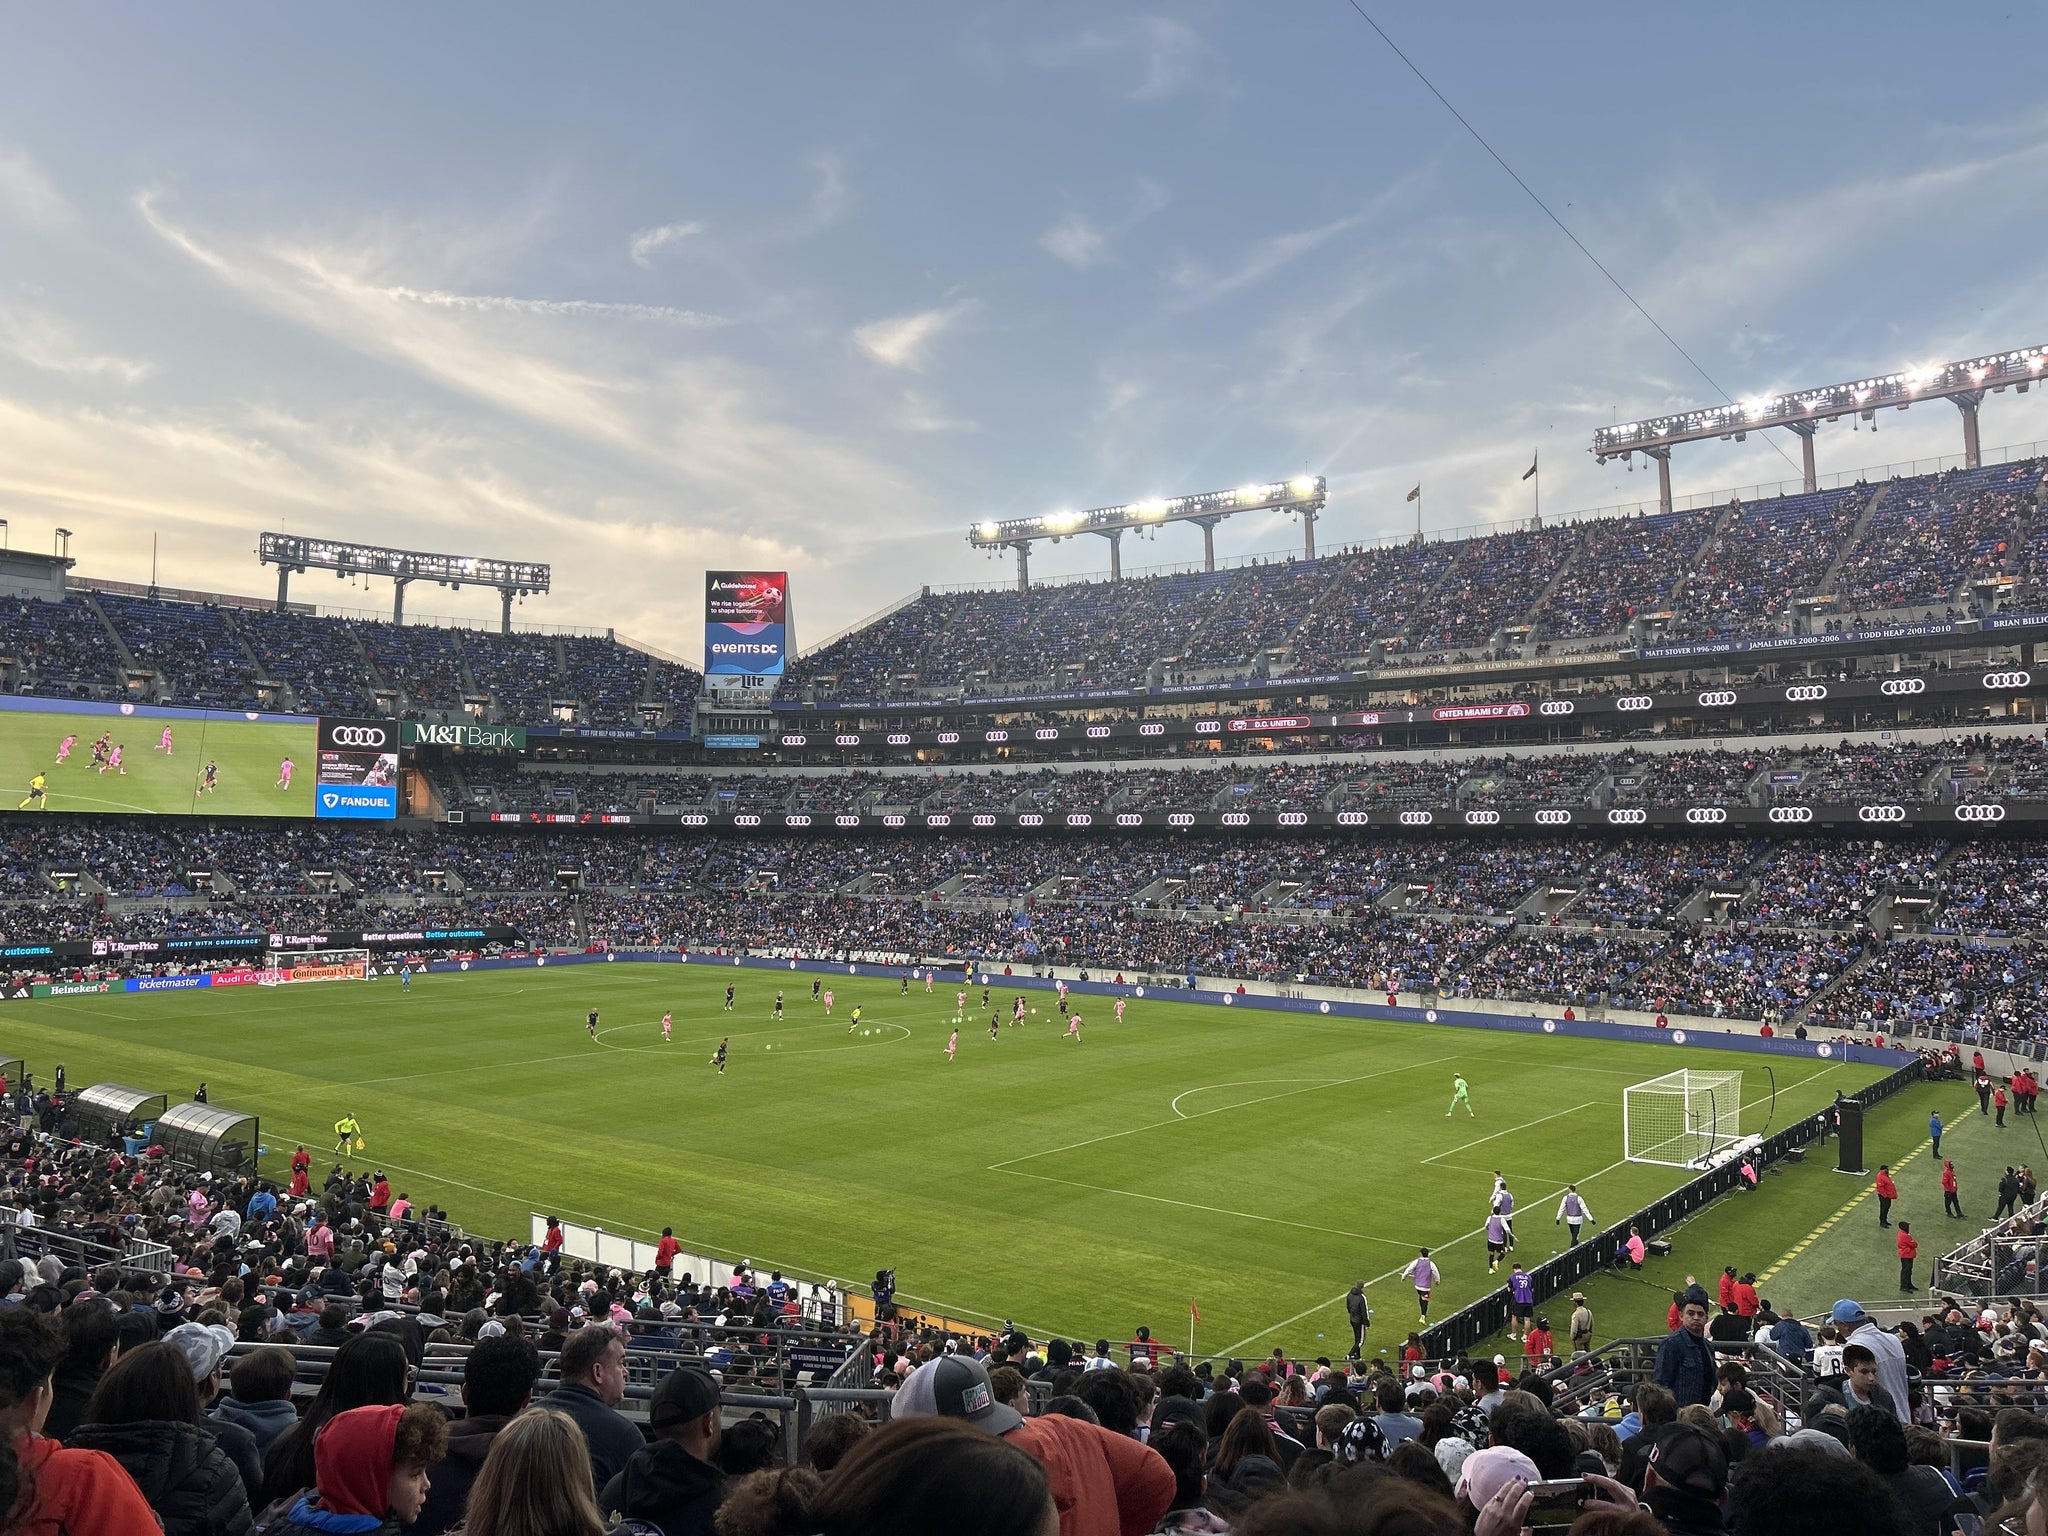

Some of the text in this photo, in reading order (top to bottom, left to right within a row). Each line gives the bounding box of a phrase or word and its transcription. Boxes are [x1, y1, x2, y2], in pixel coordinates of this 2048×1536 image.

[1993, 620, 2020, 628] BRIAN
[1859, 625, 1951, 639] TODD HEAP 2001-2010
[1749, 635, 1840, 650] JAMAL LEWIS 2000-2006
[1410, 668, 1431, 676] OGDEN
[741, 675, 764, 689] Lite
[1408, 712, 1413, 722] 2
[1439, 707, 1504, 718] INTER MIAMI CF
[1332, 716, 1337, 726] 0
[415, 724, 515, 747] M&T Bank
[341, 797, 390, 807] FANDUEL
[500, 814, 520, 822] UNITED
[555, 814, 576, 822] UNITED
[610, 815, 631, 823] UNITED
[362, 933, 386, 941] Better
[387, 932, 424, 941] questions.
[449, 930, 485, 938] outcomes.
[4, 946, 54, 956] outcomes.
[292, 967, 337, 978] Continental
[139, 978, 199, 990] ticketmaster
[216, 975, 240, 984] Audi
[51, 985, 98, 995] Heineken
[1519, 1280, 1528, 1288] 39
